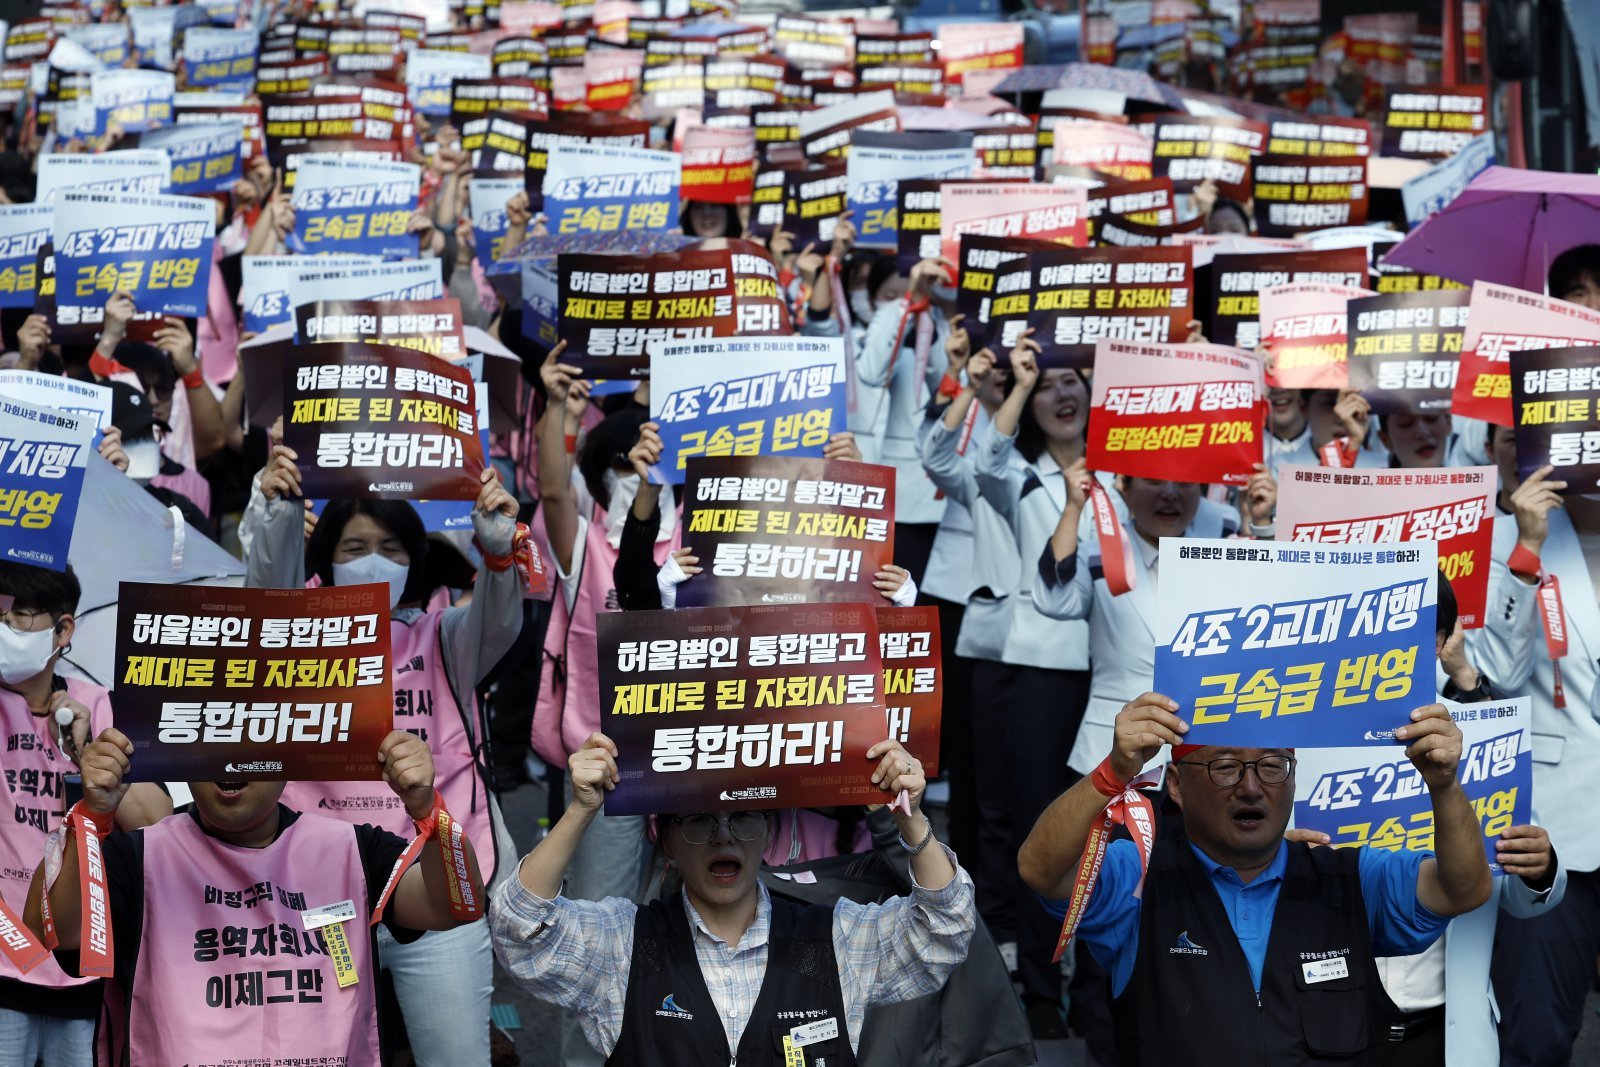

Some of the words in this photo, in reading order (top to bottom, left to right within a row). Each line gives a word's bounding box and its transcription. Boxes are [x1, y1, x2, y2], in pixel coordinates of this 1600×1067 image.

[586, 173, 634, 198] 2교대
[304, 213, 366, 242] 근속급
[558, 208, 624, 234] 근속급
[626, 203, 670, 228] 반영
[62, 232, 98, 258] 4조
[100, 225, 157, 253] 2교대
[159, 222, 204, 249] 시행
[76, 261, 145, 297] 근속급
[147, 258, 200, 289] 반영
[569, 271, 650, 293] 허울뿐인
[653, 268, 727, 293] 통합말고
[1039, 263, 1113, 287] 허울뿐인
[1115, 262, 1187, 284] 통합말고
[564, 297, 625, 320] 제대로
[631, 298, 652, 319] 된
[656, 295, 733, 319] 자회사로
[1034, 289, 1090, 311] 제대로
[1095, 289, 1115, 309] 된
[1117, 288, 1189, 309] 자회사로
[1054, 315, 1171, 345] 통합하라!
[1357, 306, 1435, 332] 허울뿐인
[664, 346, 691, 356] 허울뿐인
[1354, 334, 1413, 356] 제대로
[1418, 333, 1439, 354] 된
[297, 365, 388, 391] 허울뿐인
[394, 367, 468, 404] 통합말고
[660, 389, 702, 423] 4조
[707, 377, 777, 416] 2교대
[779, 365, 835, 403] 시행
[1104, 383, 1200, 416] 직급체계
[1199, 381, 1255, 411] 정상화
[3, 402, 38, 422] 자회사로
[38, 410, 79, 432] 통합하라!
[290, 398, 361, 424] 제대로
[368, 398, 393, 422] 된
[398, 399, 474, 435] 자회사로
[1521, 399, 1590, 426] 제대로
[316, 432, 464, 468] 통합하라!
[676, 420, 765, 470] 근속급
[772, 408, 832, 452] 반영
[1105, 423, 1206, 452] 명절상여금
[1208, 420, 1254, 446] 120%
[8, 441, 76, 479] 시행
[697, 478, 788, 502] 허울뿐인
[795, 480, 887, 510] 통합말고
[1295, 469, 1332, 484] 허울뿐인
[1334, 470, 1374, 487] 통합말고,
[1376, 472, 1402, 485] 제대로
[1403, 472, 1413, 485] 된
[1415, 472, 1449, 485] 자회사로
[1450, 472, 1485, 485] 통합하라!
[689, 509, 760, 533] 제대로
[766, 511, 790, 535] 된
[795, 512, 888, 542] 자회사로
[1408, 499, 1488, 541] 정상화
[712, 543, 862, 582] 통합하라!
[1179, 545, 1224, 561] 허울뿐인
[1225, 547, 1274, 564] 통합말고,
[1277, 548, 1312, 564] 제대로
[1314, 549, 1326, 565] 된
[1328, 550, 1374, 565] 자회사로
[1375, 548, 1421, 564] 통합하라!
[305, 592, 375, 612] 근속급반영
[132, 613, 252, 648] 허울뿐인
[259, 612, 380, 649] 통합말고
[1171, 612, 1232, 658] 4조
[1241, 597, 1351, 652] 2교대
[1351, 581, 1425, 637] 시행
[617, 637, 740, 673] 허울뿐인
[748, 632, 867, 667] 통합말고
[123, 655, 216, 688] 제대로
[225, 658, 257, 688] 된
[263, 655, 385, 689] 자회사로
[1192, 660, 1327, 726] 근속급
[1331, 645, 1420, 708] 반영
[611, 681, 706, 715] 제대로
[716, 679, 747, 711] 된
[754, 674, 875, 710] 자회사로
[158, 701, 353, 744] 통합하라!
[1480, 704, 1519, 720] 통합하라!
[651, 720, 844, 773] 통합하라!
[1308, 770, 1366, 812] 4조
[1461, 731, 1523, 786] 시행
[453, 848, 468, 880] 4조2교대
[205, 880, 274, 910] 비정규직
[459, 879, 476, 906] 지금당장
[1064, 884, 1086, 935] 명절상여금
[88, 881, 107, 956] 통합하라!
[193, 922, 331, 963] 용역자회사
[205, 968, 325, 1010] 이제그만
